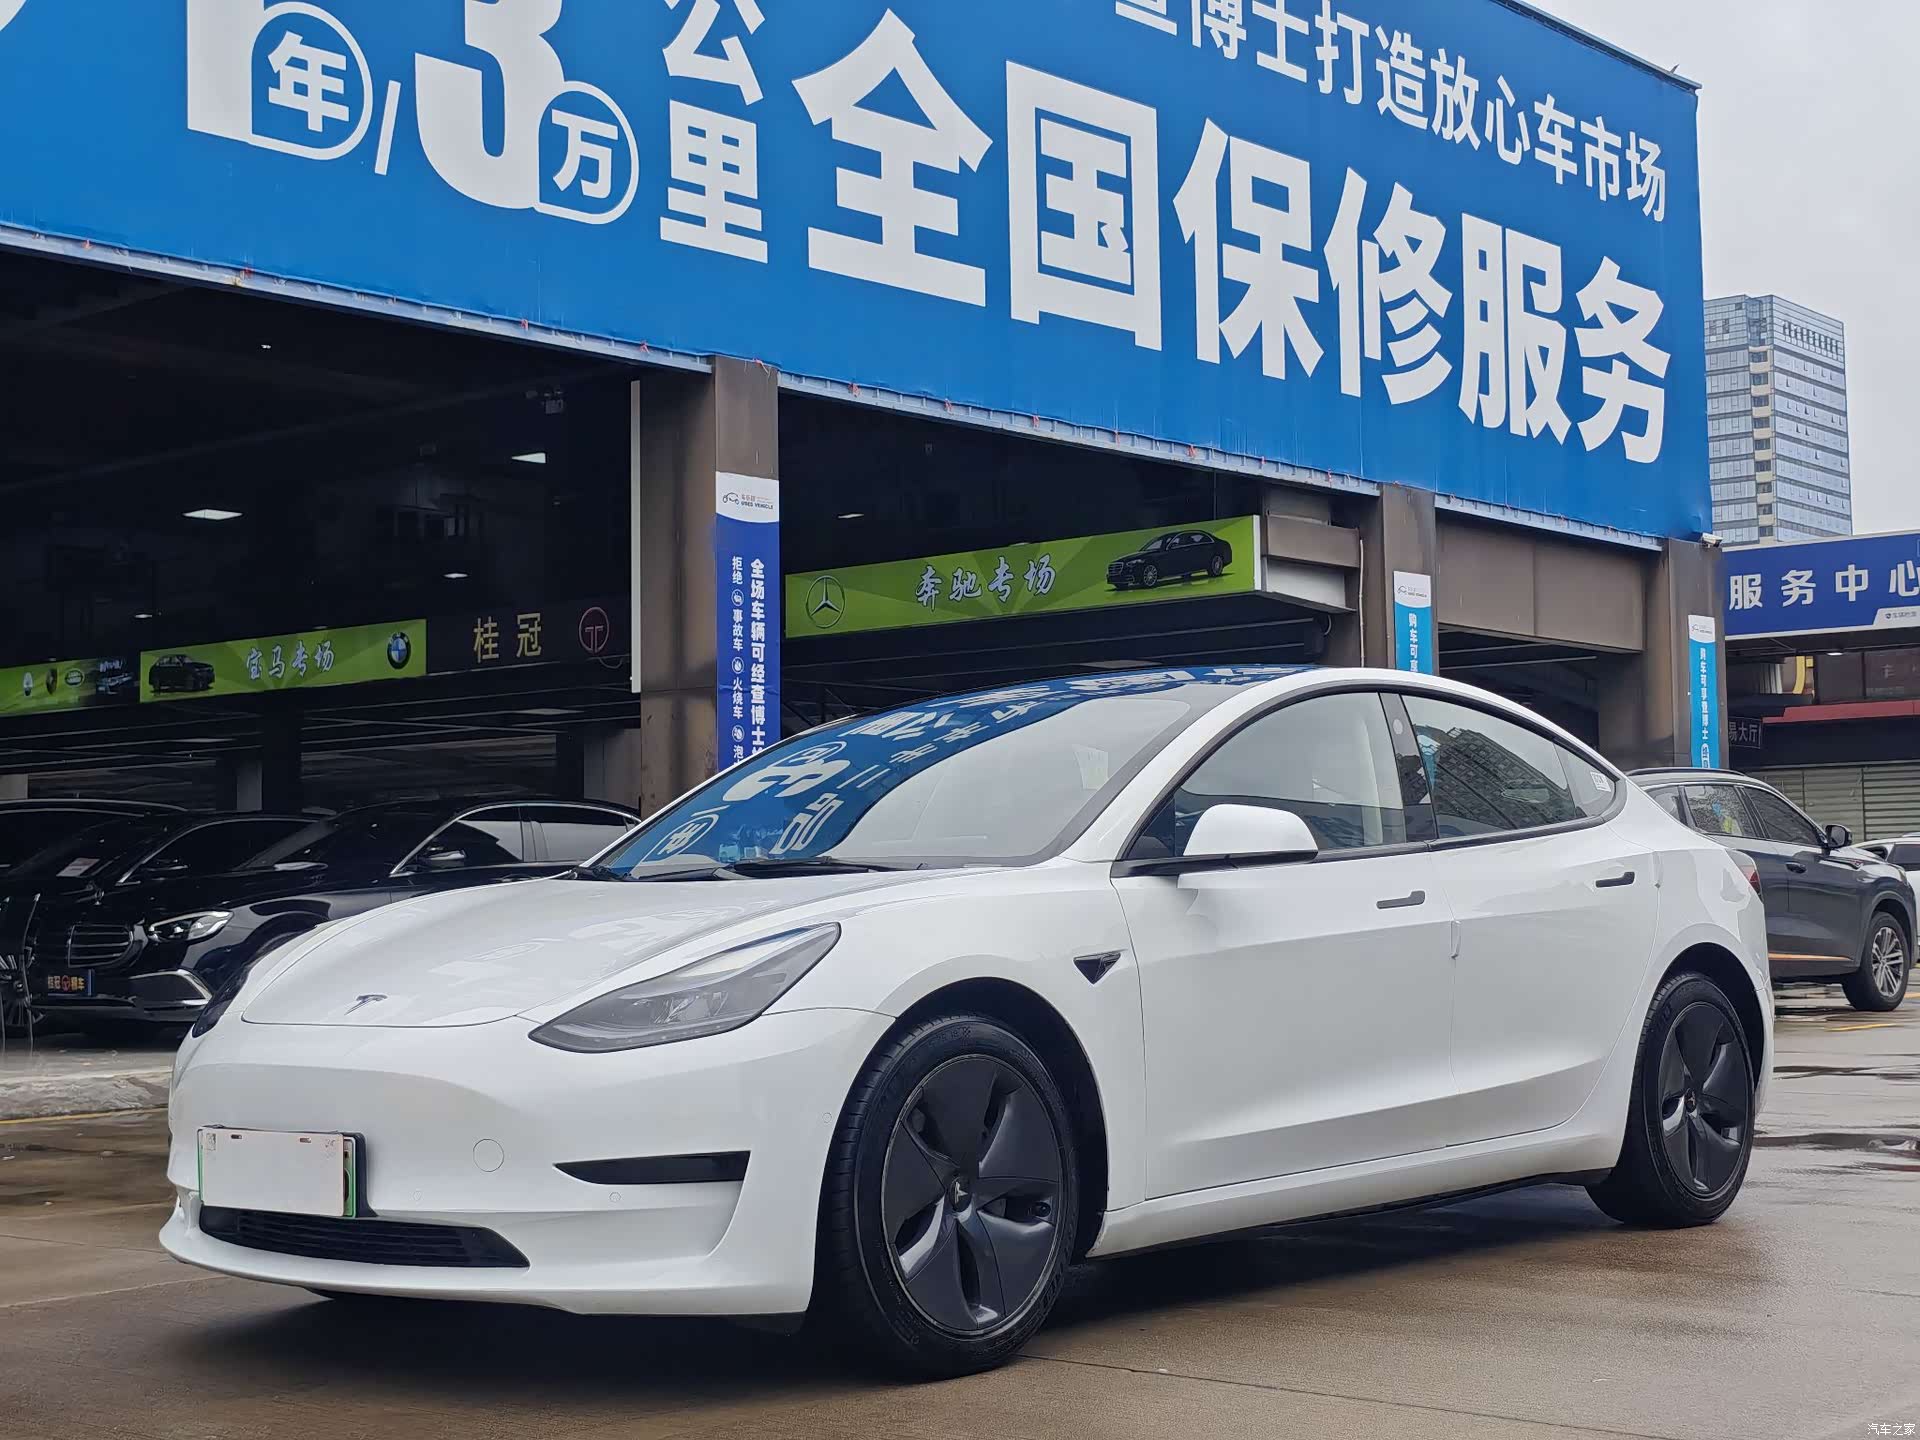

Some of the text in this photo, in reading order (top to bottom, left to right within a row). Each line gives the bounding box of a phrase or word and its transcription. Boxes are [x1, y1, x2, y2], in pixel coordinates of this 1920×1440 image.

[791, 8, 1671, 464] 全国保修服务
[731, 556, 743, 585] 拒绝
[915, 553, 1057, 613] 奔驰专场
[1729, 560, 1920, 611] 服务中心
[473, 612, 542, 664] 桂冠
[732, 608, 744, 652] 事故车
[246, 640, 336, 680] 宝马专场
[732, 676, 744, 720] 火烧车
